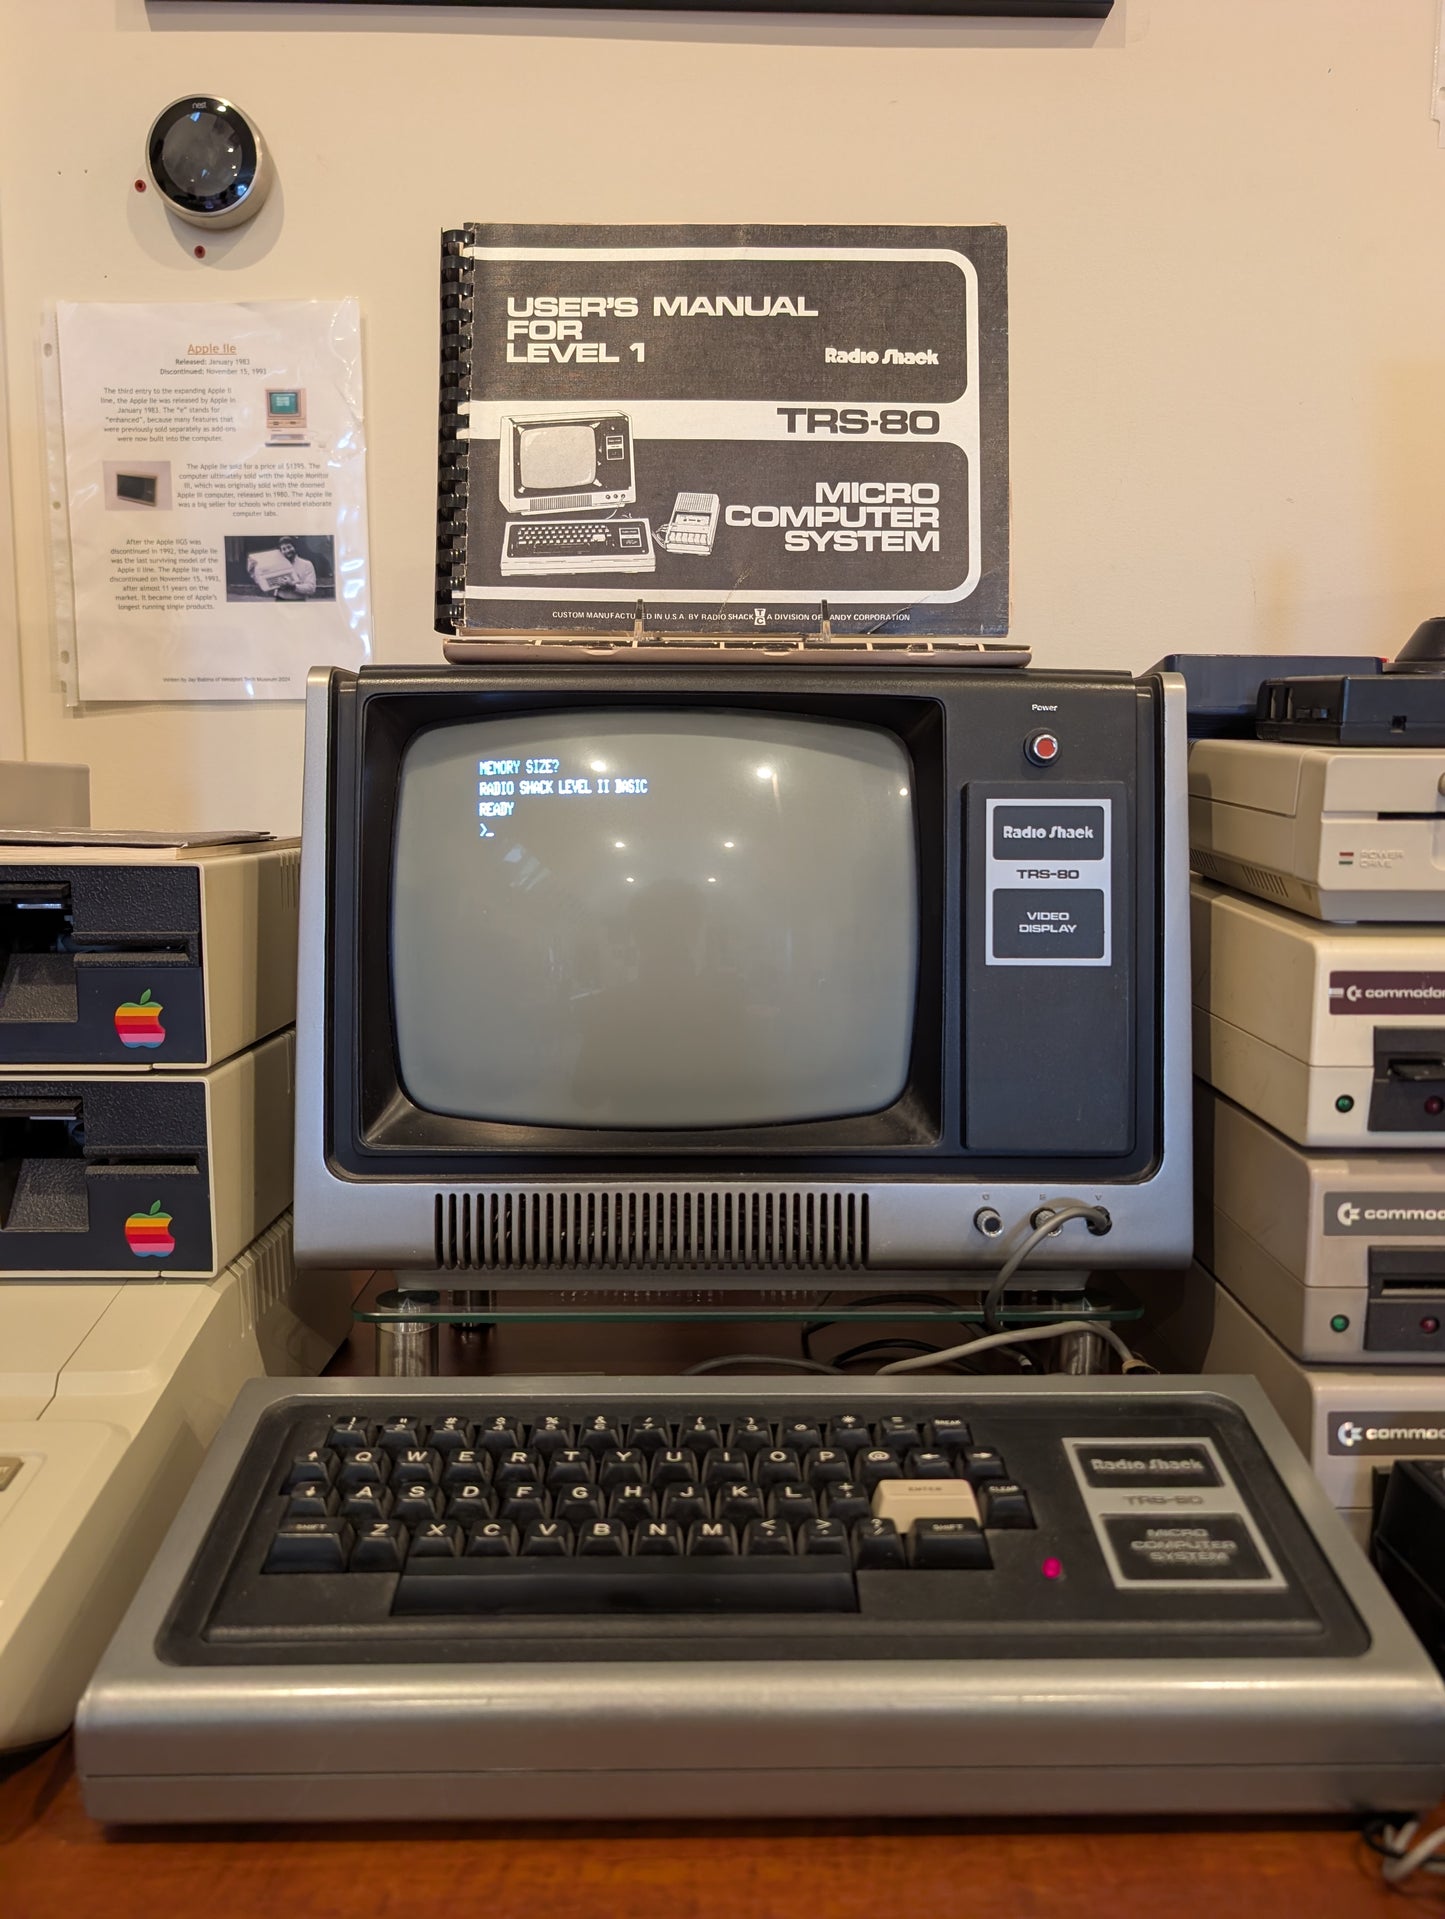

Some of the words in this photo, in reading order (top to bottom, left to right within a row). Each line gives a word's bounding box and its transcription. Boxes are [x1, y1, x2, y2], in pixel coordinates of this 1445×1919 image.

[506, 297, 638, 317] USER'S
[654, 296, 818, 317] MANUAL
[506, 320, 582, 340] FOR
[187, 344, 219, 355] Apple
[223, 344, 238, 354] IIe
[506, 343, 619, 363] LEVEL
[629, 343, 645, 363] 1
[825, 347, 878, 365] Radio
[881, 347, 939, 365] Shack
[209, 358, 233, 367] January
[241, 368, 249, 377] 15,
[777, 407, 940, 434] TRS-80
[815, 482, 940, 504] MICRO
[725, 505, 940, 528] COMPUTER
[785, 530, 940, 552] SYSTEM
[1032, 704, 1057, 712] Power
[479, 760, 520, 775] MEMORY
[526, 759, 559, 774] SIZE?
[479, 781, 514, 796] RADIO
[520, 781, 554, 794] SHACK
[558, 780, 592, 794] LEVEL
[598, 780, 609, 793] II
[615, 779, 648, 793] BASIC
[479, 802, 515, 816] READY
[1003, 826, 1047, 839] Radio
[1049, 825, 1093, 839] Shack
[1016, 870, 1080, 879] TRS-80
[1027, 912, 1069, 920] VIDEO
[1019, 924, 1077, 933] DISPLAY
[355, 1451, 371, 1462] Q
[407, 1451, 427, 1461] W
[459, 1451, 475, 1462] E
[511, 1452, 527, 1462] R
[564, 1451, 580, 1461] T
[617, 1451, 631, 1462] Y
[667, 1451, 682, 1462] U
[724, 1452, 728, 1462] I
[770, 1451, 786, 1462] O
[820, 1452, 835, 1462] P
[869, 1451, 890, 1461] @
[1091, 1459, 1145, 1470] Radio
[1149, 1459, 1203, 1470] Shack
[356, 1486, 373, 1497] A
[410, 1486, 425, 1497] S
[463, 1486, 479, 1497] D
[517, 1486, 533, 1497] F
[572, 1486, 588, 1498] G
[625, 1486, 641, 1497] H
[681, 1486, 693, 1497] J
[733, 1486, 748, 1497] K
[786, 1486, 802, 1497] L
[371, 1524, 389, 1536] Z
[428, 1524, 447, 1536] X
[484, 1524, 501, 1535] C
[540, 1524, 557, 1535] V
[594, 1524, 610, 1535] B
[650, 1524, 666, 1535] N
[703, 1524, 722, 1535] M
[1147, 1529, 1208, 1537] MICRO
[1131, 1541, 1237, 1549] COMPUTER
[1150, 1552, 1228, 1560] SYSTEM
